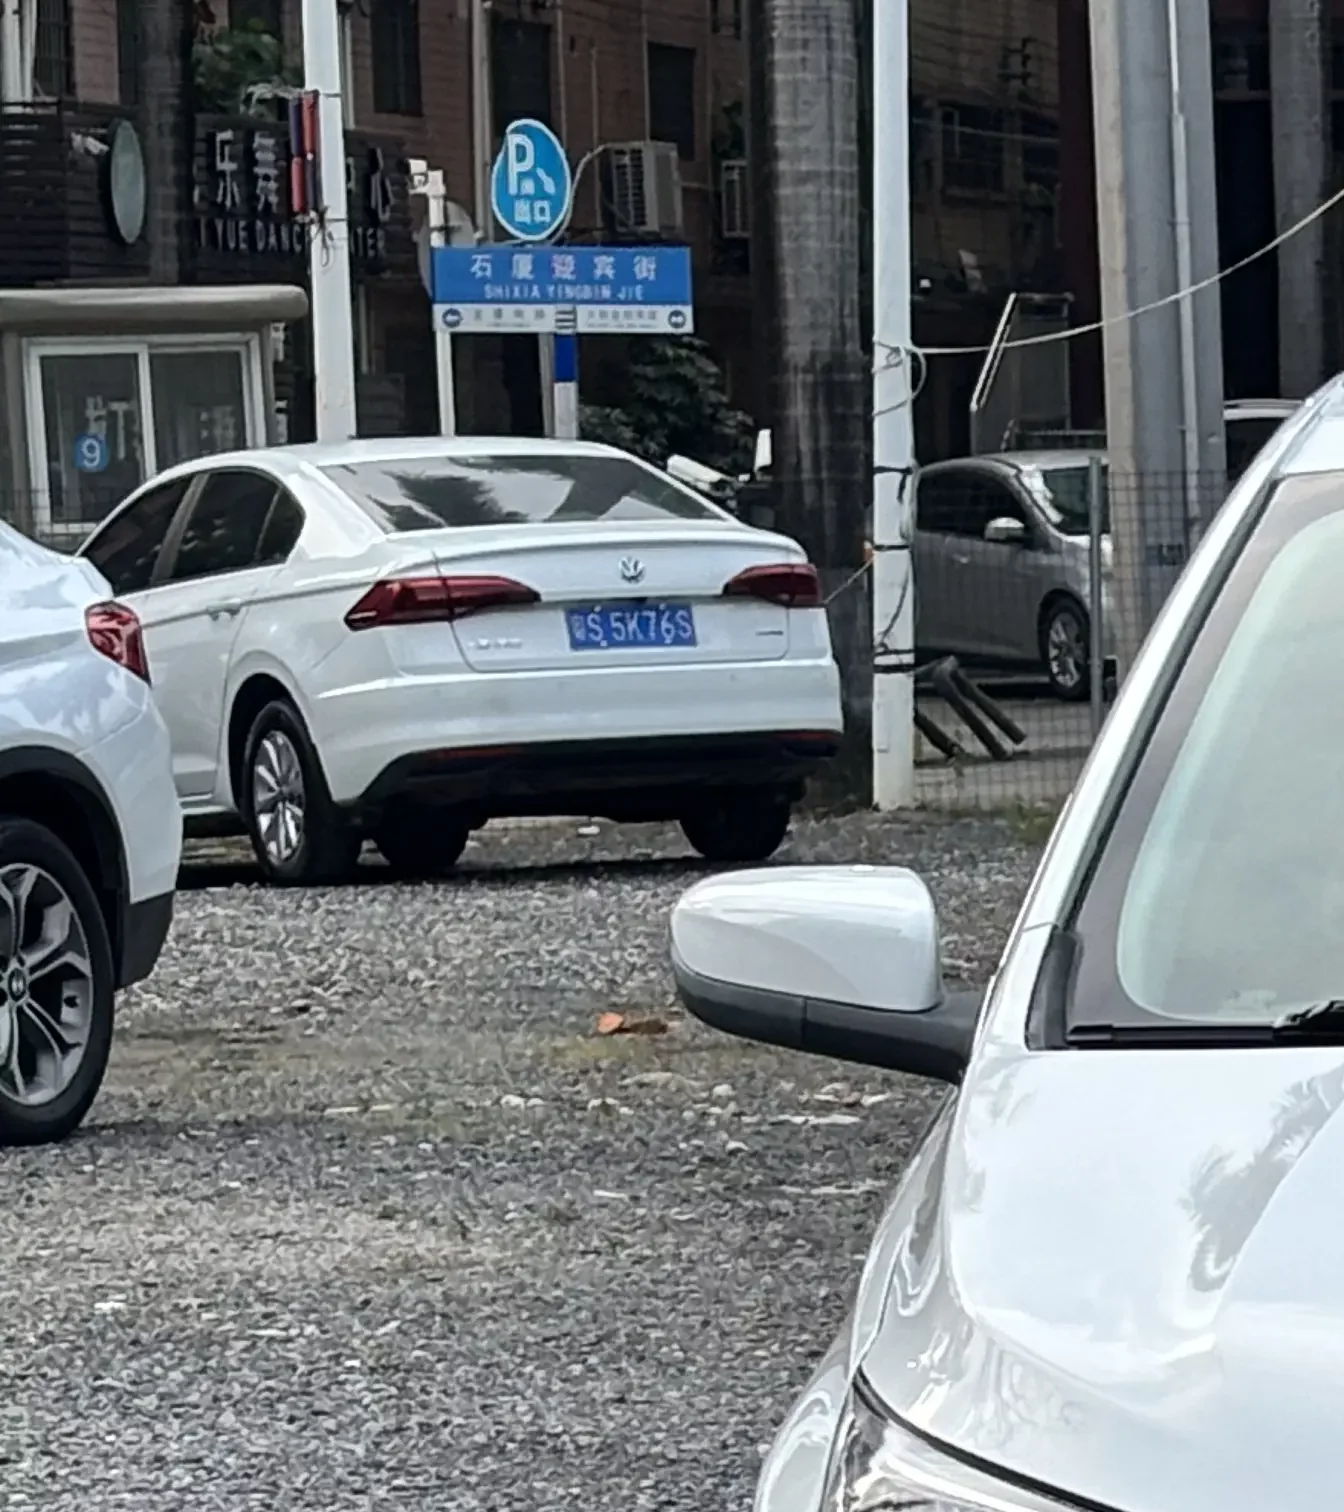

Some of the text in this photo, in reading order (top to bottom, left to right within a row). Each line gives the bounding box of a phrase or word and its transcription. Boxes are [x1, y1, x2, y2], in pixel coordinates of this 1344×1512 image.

[508, 133, 535, 196] P
[256, 219, 310, 251] DANC
[617, 284, 645, 301] JIE
[81, 437, 101, 468] 9
